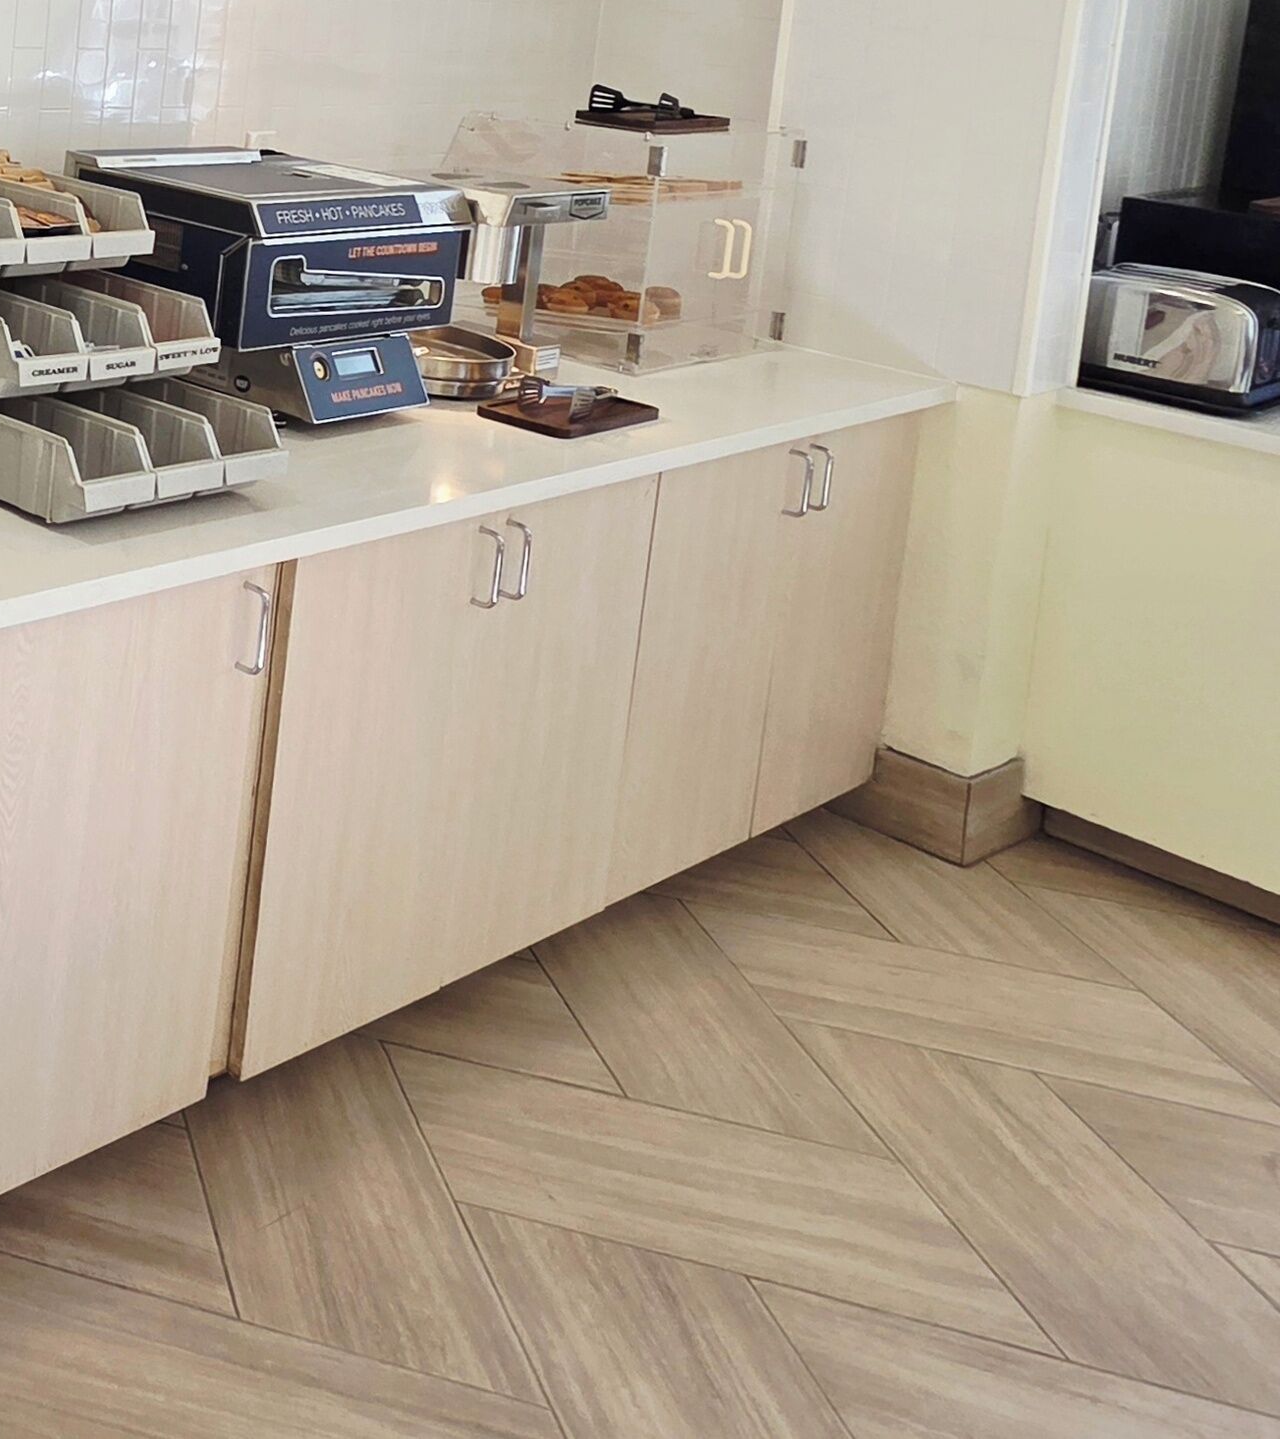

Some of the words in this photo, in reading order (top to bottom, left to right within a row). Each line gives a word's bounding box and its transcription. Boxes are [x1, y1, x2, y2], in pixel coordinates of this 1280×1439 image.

[276, 209, 315, 224] FRESH
[322, 206, 344, 221] HOT
[351, 203, 407, 219] PANCAKES
[159, 351, 188, 361] SWEET
[200, 346, 219, 355] LOW
[32, 366, 78, 377] CREAMER
[105, 361, 136, 370] SUGAR
